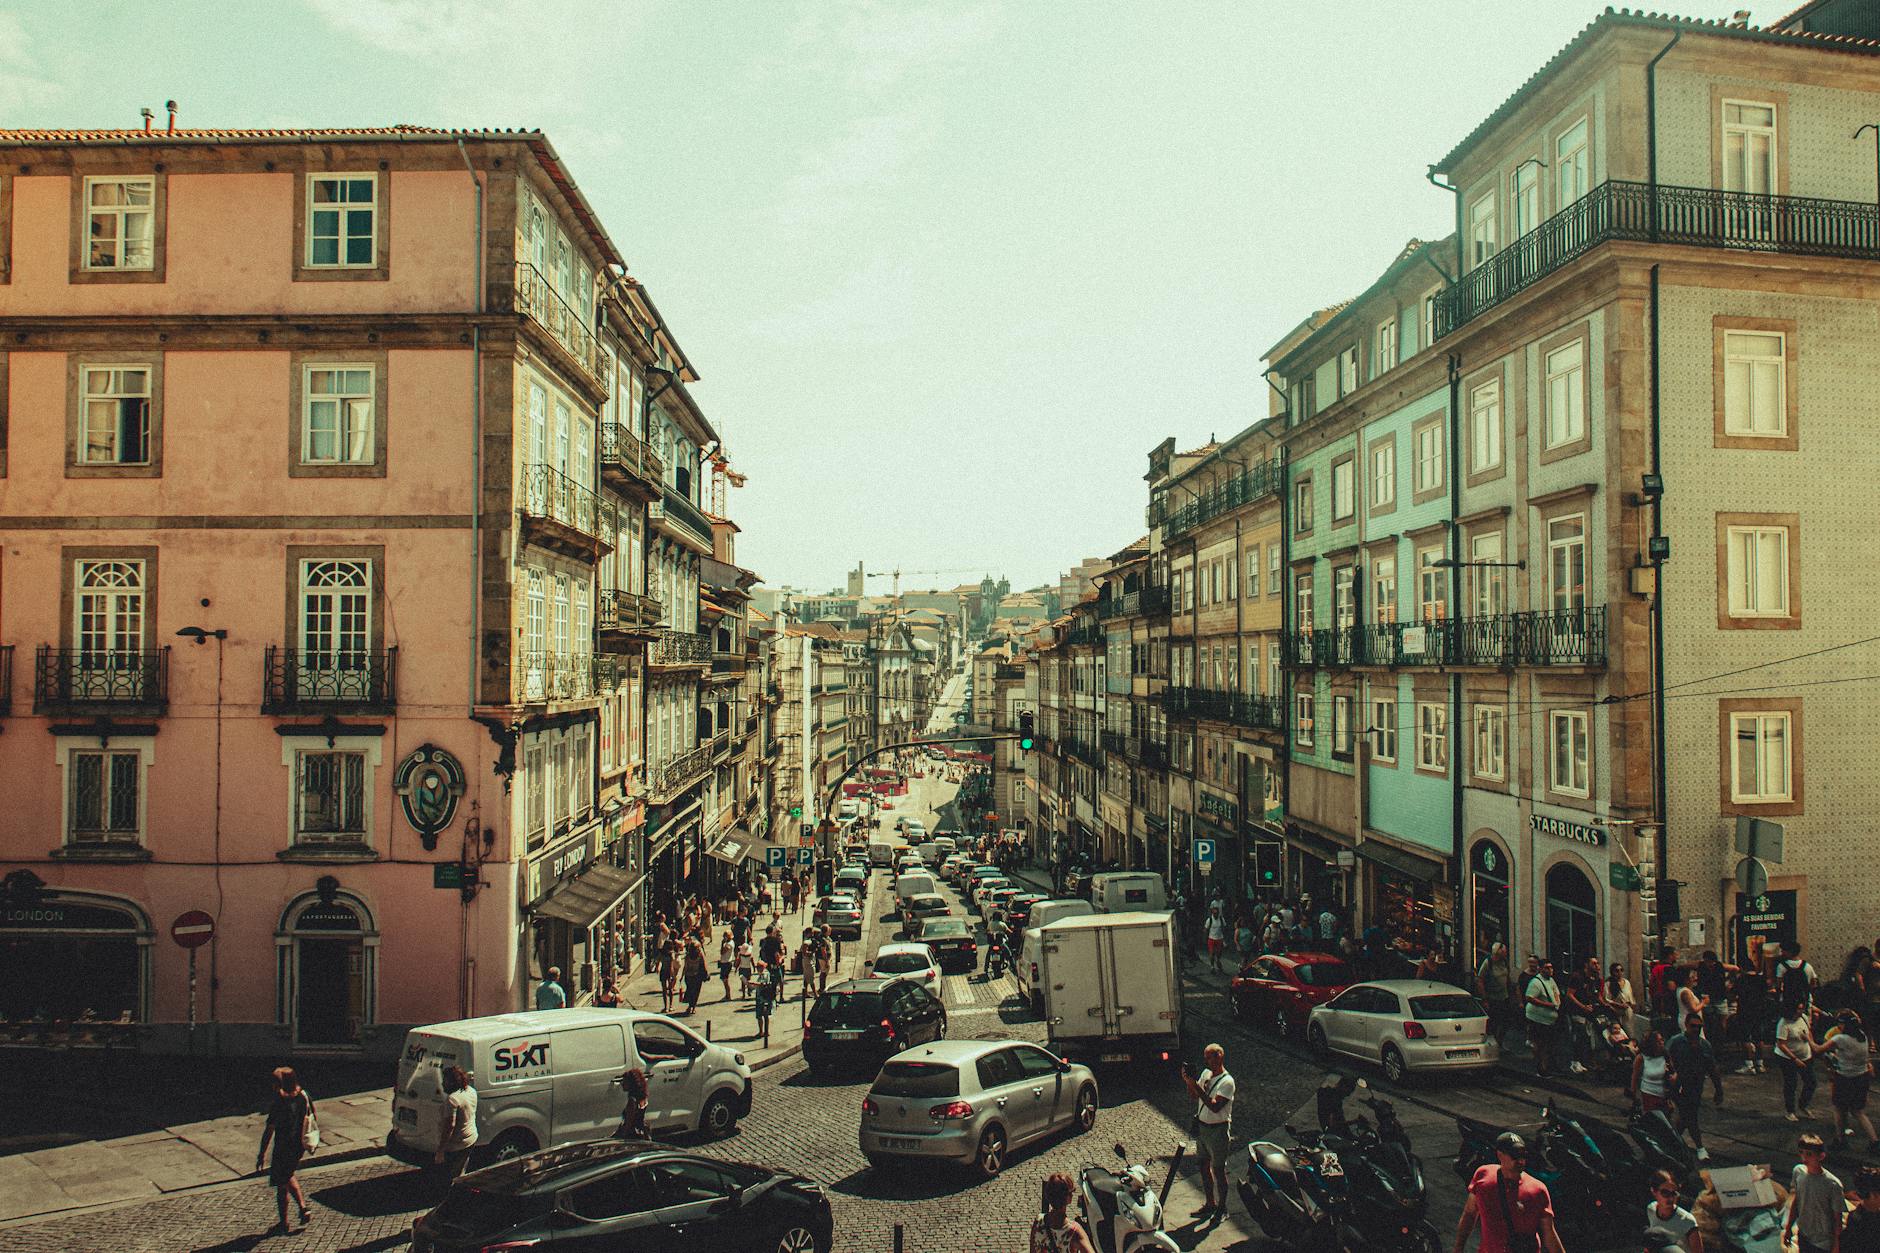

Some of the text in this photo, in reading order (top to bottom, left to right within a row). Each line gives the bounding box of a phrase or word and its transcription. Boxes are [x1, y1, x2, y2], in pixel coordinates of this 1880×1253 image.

[1529, 814, 1598, 846] STARBUCKS
[770, 849, 782, 865] P
[800, 850, 810, 863] P
[1198, 842, 1211, 860] P
[7, 910, 64, 921] LONDON
